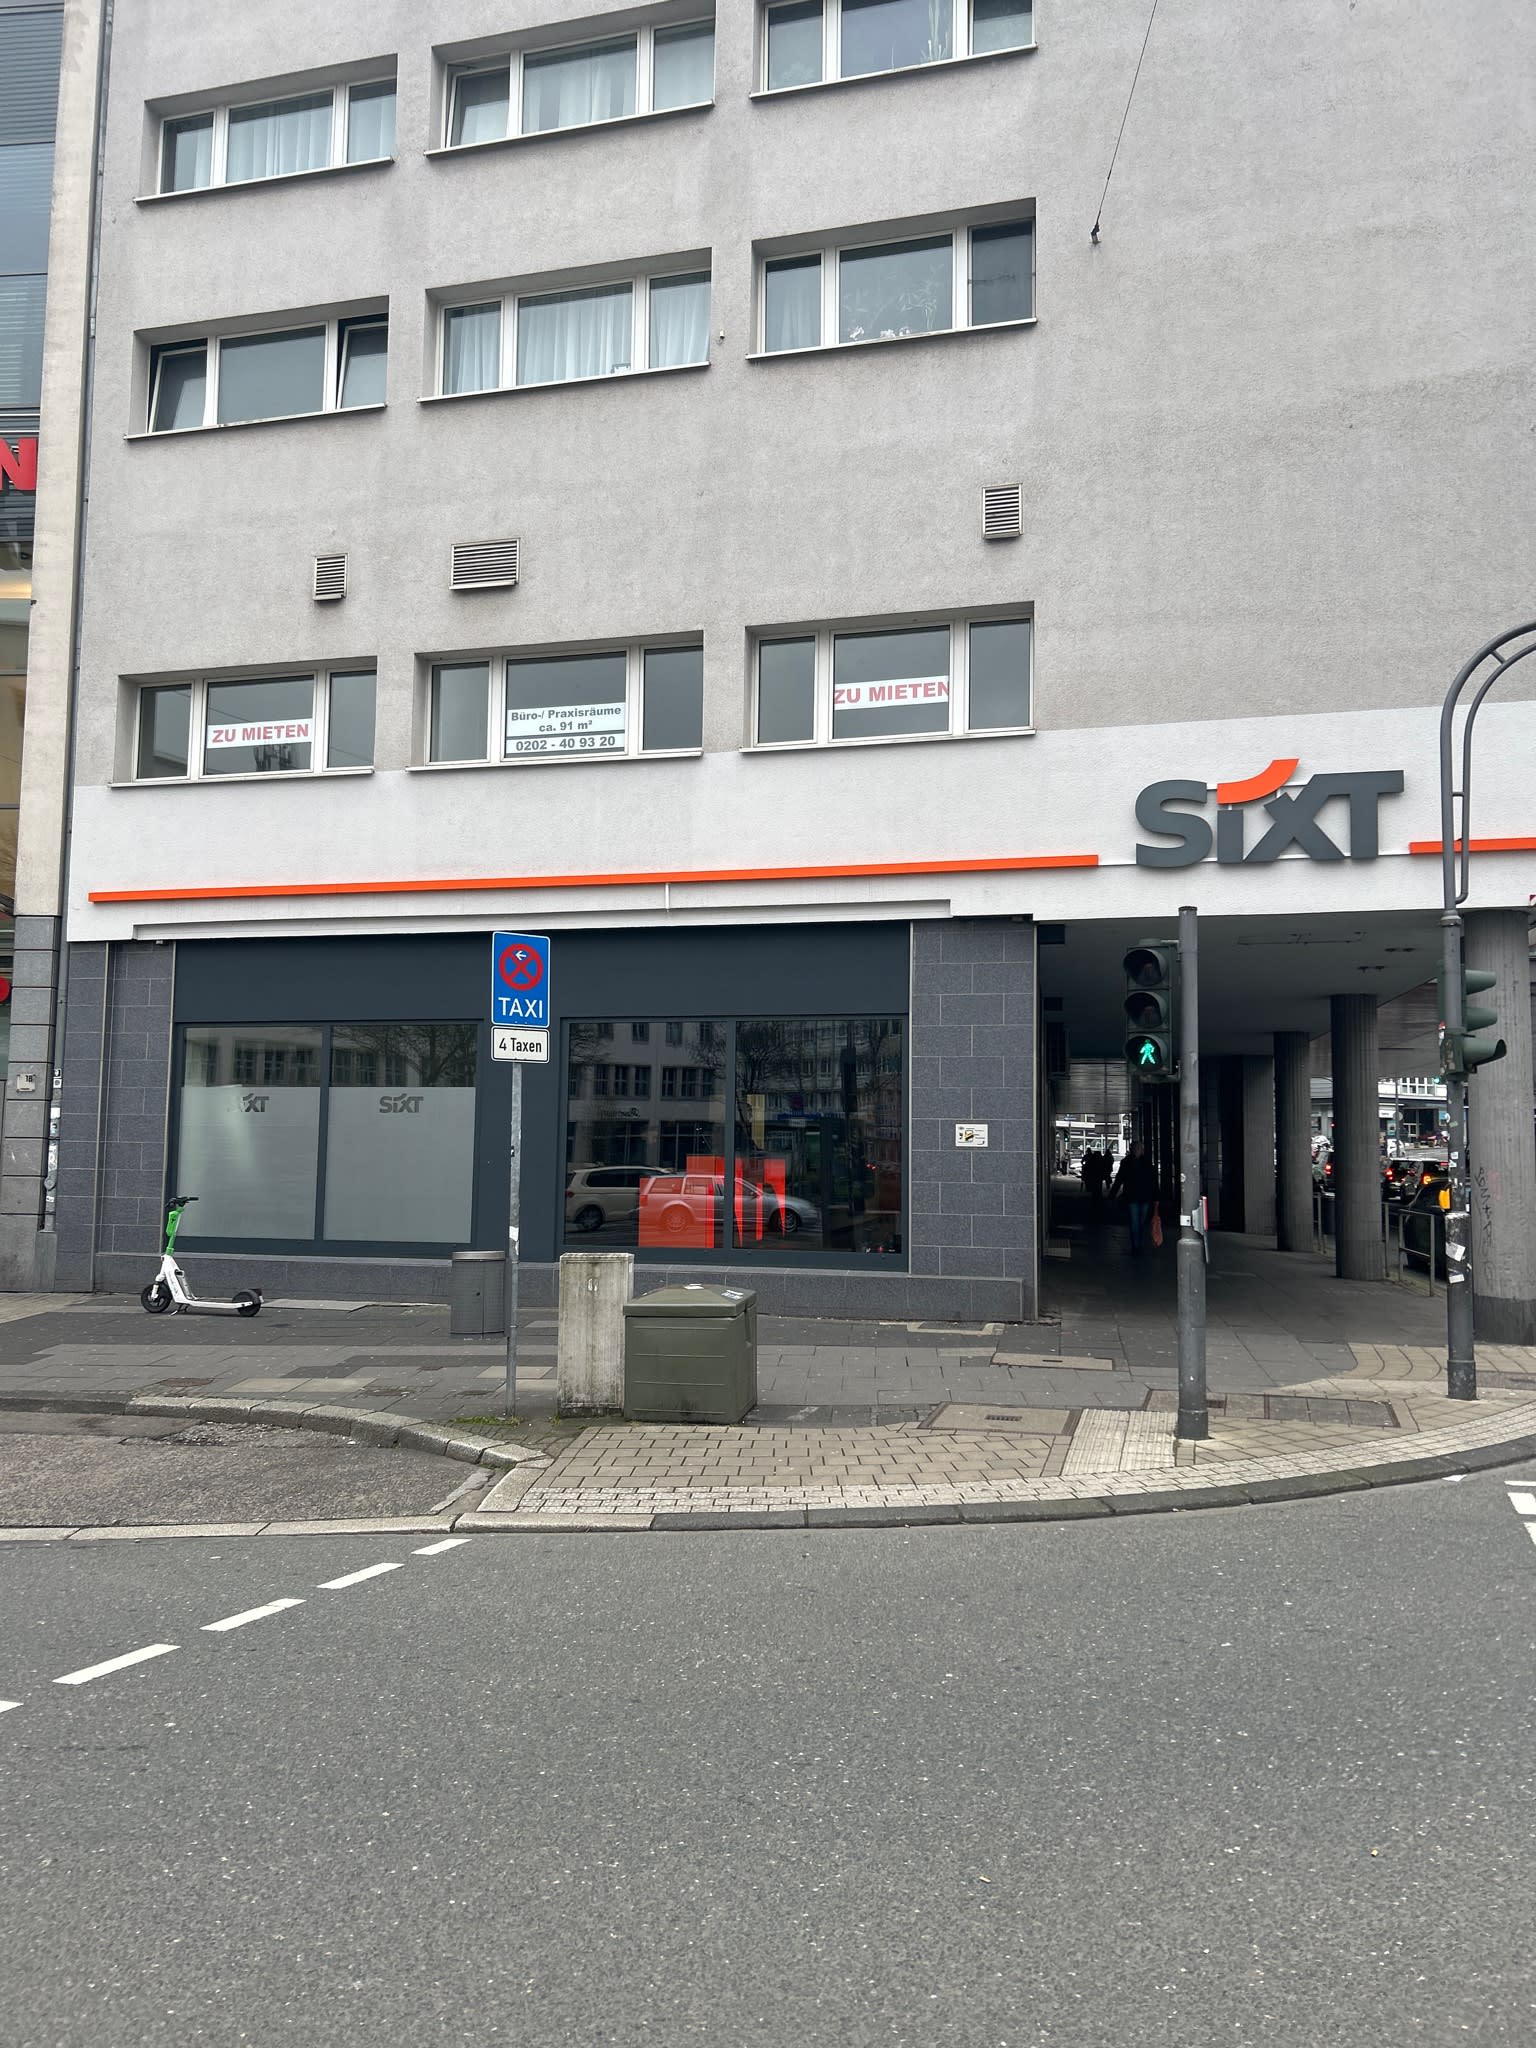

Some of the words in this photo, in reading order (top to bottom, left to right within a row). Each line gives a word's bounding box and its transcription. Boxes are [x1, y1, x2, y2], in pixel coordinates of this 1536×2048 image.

[834, 688, 861, 704] ZU
[869, 682, 949, 702] MIETEN
[511, 710, 545, 721] Büro-/
[548, 707, 622, 718] Praxisräume
[212, 729, 236, 743] ZU
[242, 724, 309, 741] MIETEN
[560, 721, 573, 731] 91
[577, 720, 593, 730] m²
[516, 740, 548, 751] 0202
[559, 738, 575, 749] 40
[579, 737, 595, 748] 93
[599, 736, 616, 747] 20
[498, 997, 543, 1019] TAXI
[499, 1038, 507, 1051] 4
[510, 1037, 542, 1053] Taxen
